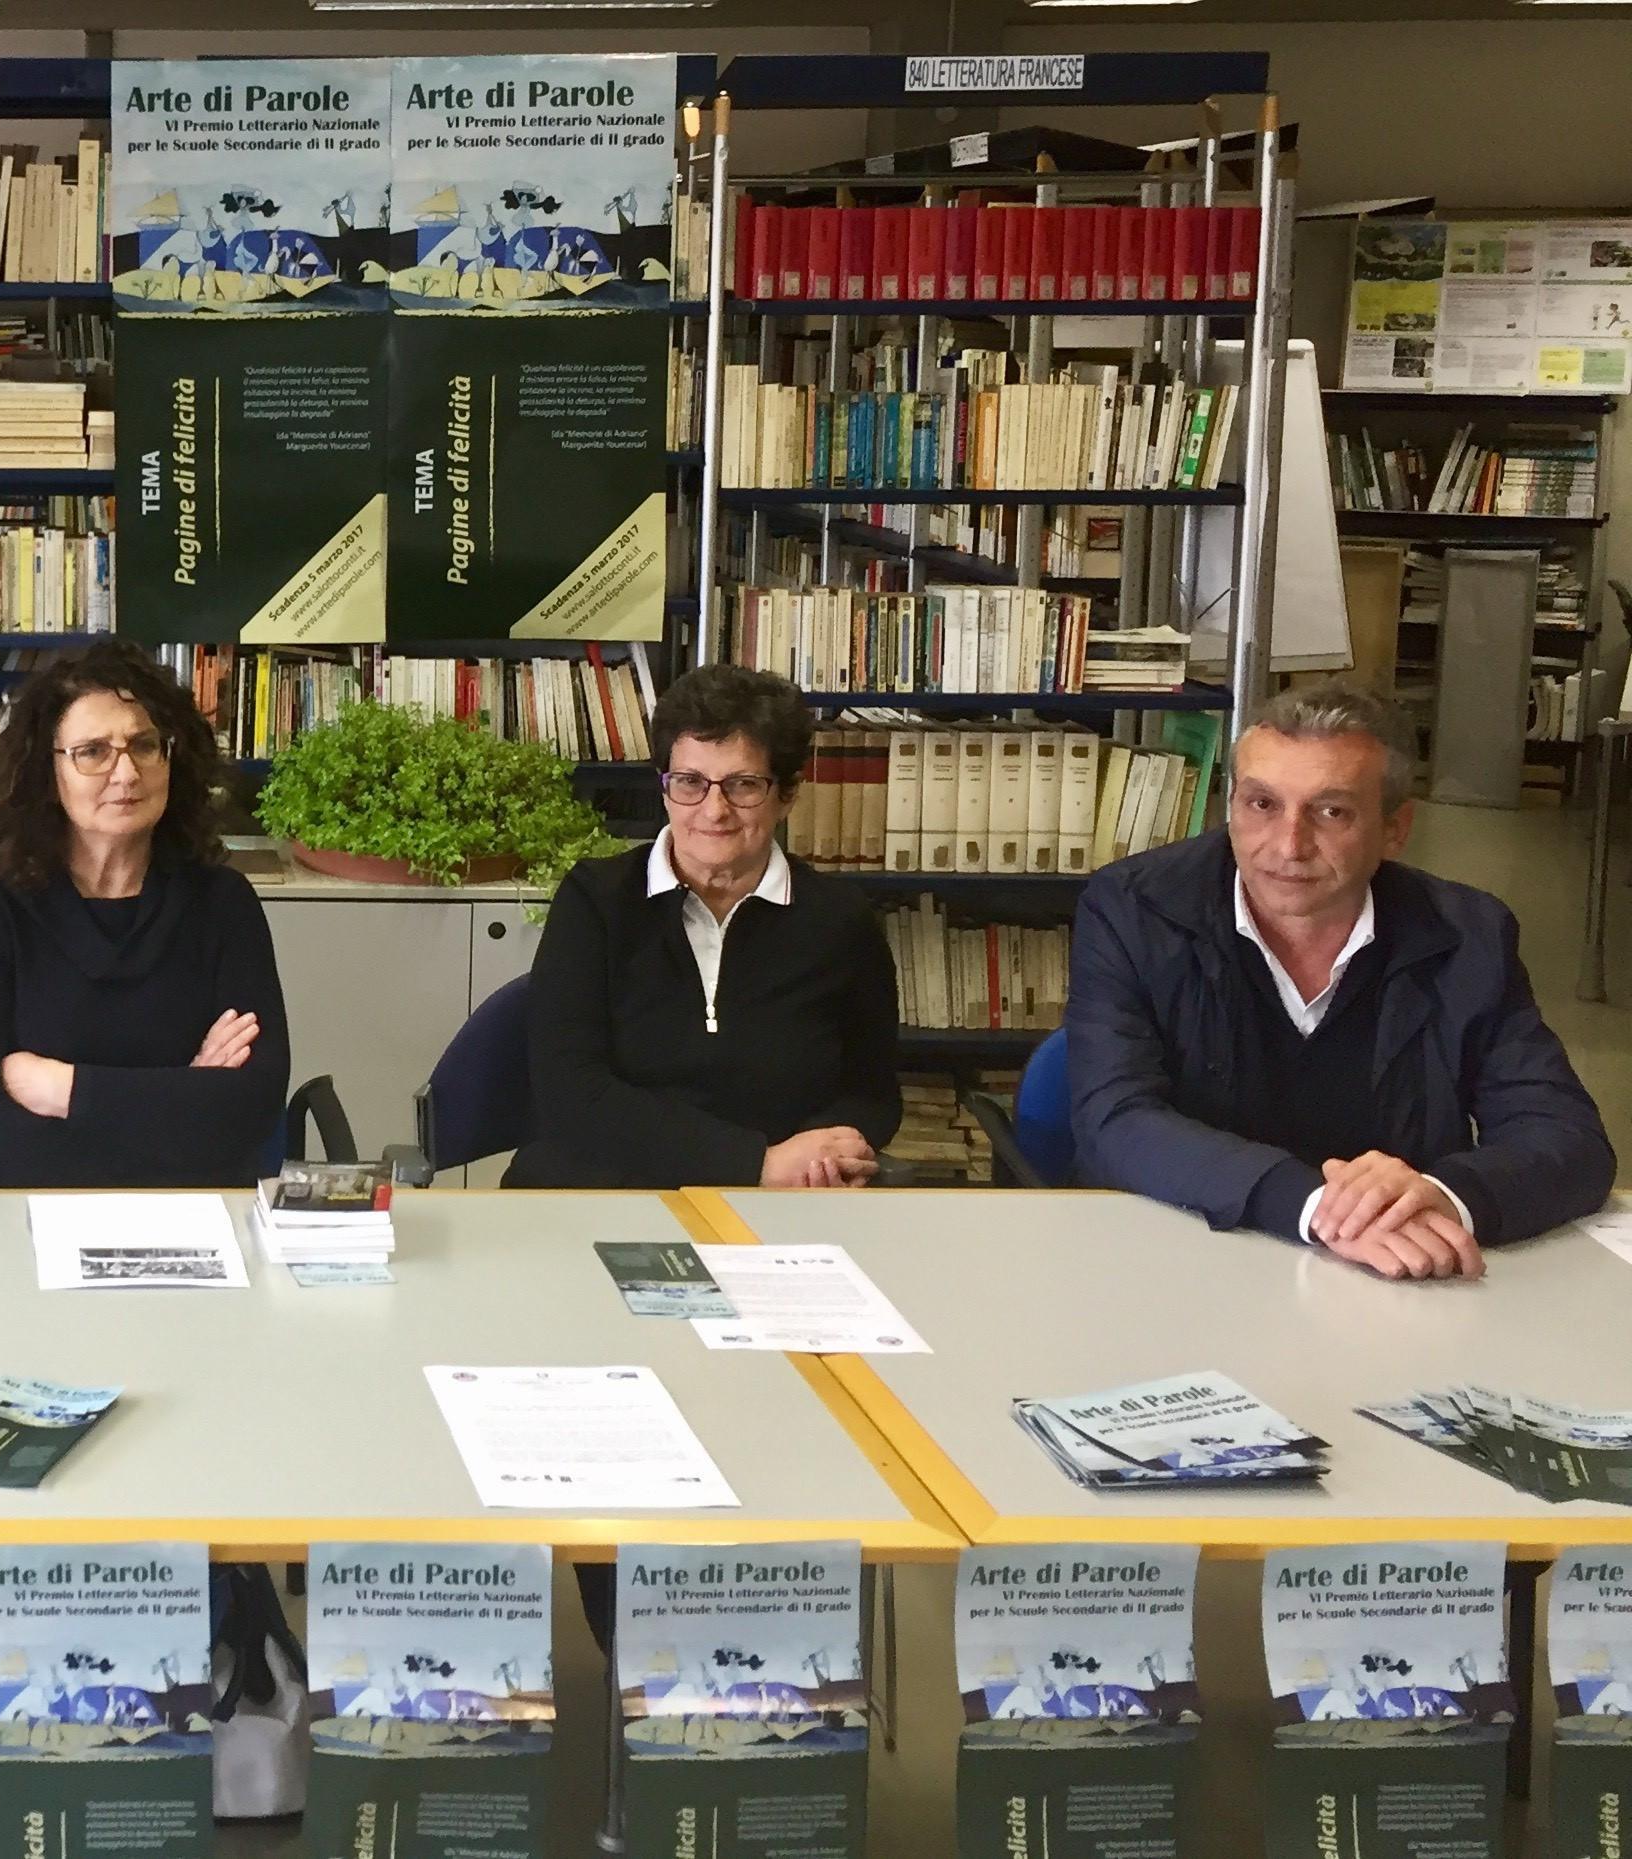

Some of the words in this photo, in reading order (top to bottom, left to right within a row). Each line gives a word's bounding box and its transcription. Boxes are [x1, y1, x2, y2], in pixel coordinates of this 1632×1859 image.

[908, 60, 929, 87] 840
[932, 60, 1015, 87] LETTERATURA
[1019, 58, 1082, 86] FRANCESE
[126, 86, 191, 112] Arte
[203, 86, 232, 111] di
[246, 85, 349, 111] Parole
[407, 84, 473, 110] Arte
[486, 81, 514, 108] di
[529, 80, 634, 107] Parole
[165, 120, 179, 132] VI
[184, 120, 233, 131] Premio
[239, 119, 307, 131] Letterario
[312, 118, 380, 130] Nazionale
[446, 116, 459, 128] VI
[465, 115, 516, 127] Premio
[522, 114, 592, 127] Letterario
[597, 113, 665, 126] Nazionale
[128, 141, 151, 153] per
[156, 140, 168, 151] le
[173, 139, 218, 151] Scuole
[224, 138, 302, 150] Secondarie
[307, 138, 319, 149] di
[325, 138, 334, 149] II
[339, 137, 380, 151] grado
[408, 138, 431, 151] per
[437, 136, 448, 147] le
[454, 135, 500, 147] Scuole
[506, 134, 585, 147] Secondarie
[591, 133, 603, 145] di
[609, 133, 617, 144] II
[623, 132, 664, 147] grado
[172, 378, 195, 464] felicità
[447, 375, 471, 462] felicità
[142, 451, 160, 515] TEMA
[173, 469, 196, 494] di
[415, 449, 434, 514] TEMA
[447, 468, 470, 493] di
[173, 499, 201, 585] Pagine
[447, 498, 475, 585] Pagine
[269, 580, 310, 621] Scadenza
[308, 573, 317, 582] 5
[316, 548, 343, 575] marzo
[342, 524, 364, 549] 2017
[290, 545, 367, 622] www.salottoconti.it
[540, 580, 584, 620] Scadenza
[582, 573, 591, 582] 5
[591, 548, 619, 575] marzo
[616, 524, 640, 549] 2017
[561, 546, 642, 620] www.salottoconti.it
[294, 550, 383, 638] www.artediparole.com
[565, 550, 659, 635] www.artediparole.com
[1068, 1403, 1113, 1421] Arte
[1120, 1397, 1142, 1412] di
[1145, 1384, 1217, 1408] Parole
[48, 1562, 72, 1585] di
[84, 1561, 173, 1584] Parole
[322, 1562, 379, 1585] Arte
[389, 1562, 414, 1585] di
[426, 1563, 515, 1587] Parole
[632, 1564, 689, 1587] Arte
[699, 1563, 723, 1584] di
[735, 1561, 825, 1583] Parole
[970, 1566, 1026, 1587] Arte
[1036, 1562, 1061, 1584] di
[1072, 1561, 1161, 1583] Parole
[1276, 1567, 1333, 1589] Arte
[1343, 1563, 1368, 1586] di
[1379, 1561, 1468, 1585] Parole
[1567, 1562, 1624, 1581] Arte
[665, 1590, 677, 1601] VI
[682, 1589, 725, 1599] Premio
[729, 1588, 789, 1598] Letterario
[793, 1586, 851, 1597] Nazionale
[1003, 1590, 1014, 1601] VI
[1019, 1589, 1061, 1600] Premio
[1066, 1588, 1124, 1599] Letterario
[1128, 1587, 1185, 1597] Nazionale
[1309, 1593, 1321, 1603] VI
[1325, 1591, 1368, 1601] Premio
[1373, 1590, 1432, 1600] Letterario
[1436, 1587, 1495, 1599] Nazionale
[1599, 1587, 1610, 1597] VI
[632, 1606, 652, 1618] per
[657, 1605, 666, 1616] le
[672, 1605, 712, 1615] Scuole
[716, 1603, 784, 1614] Secondarie
[787, 1602, 798, 1612] di
[815, 1601, 851, 1613] grado
[970, 1608, 989, 1619] per
[995, 1606, 1005, 1616] le
[1009, 1605, 1048, 1616] Scuole
[1052, 1604, 1118, 1615] Secondarie
[1122, 1603, 1133, 1613] di
[1150, 1602, 1184, 1614] grado
[1564, 1603, 1584, 1614] per
[1589, 1602, 1599, 1612] le
